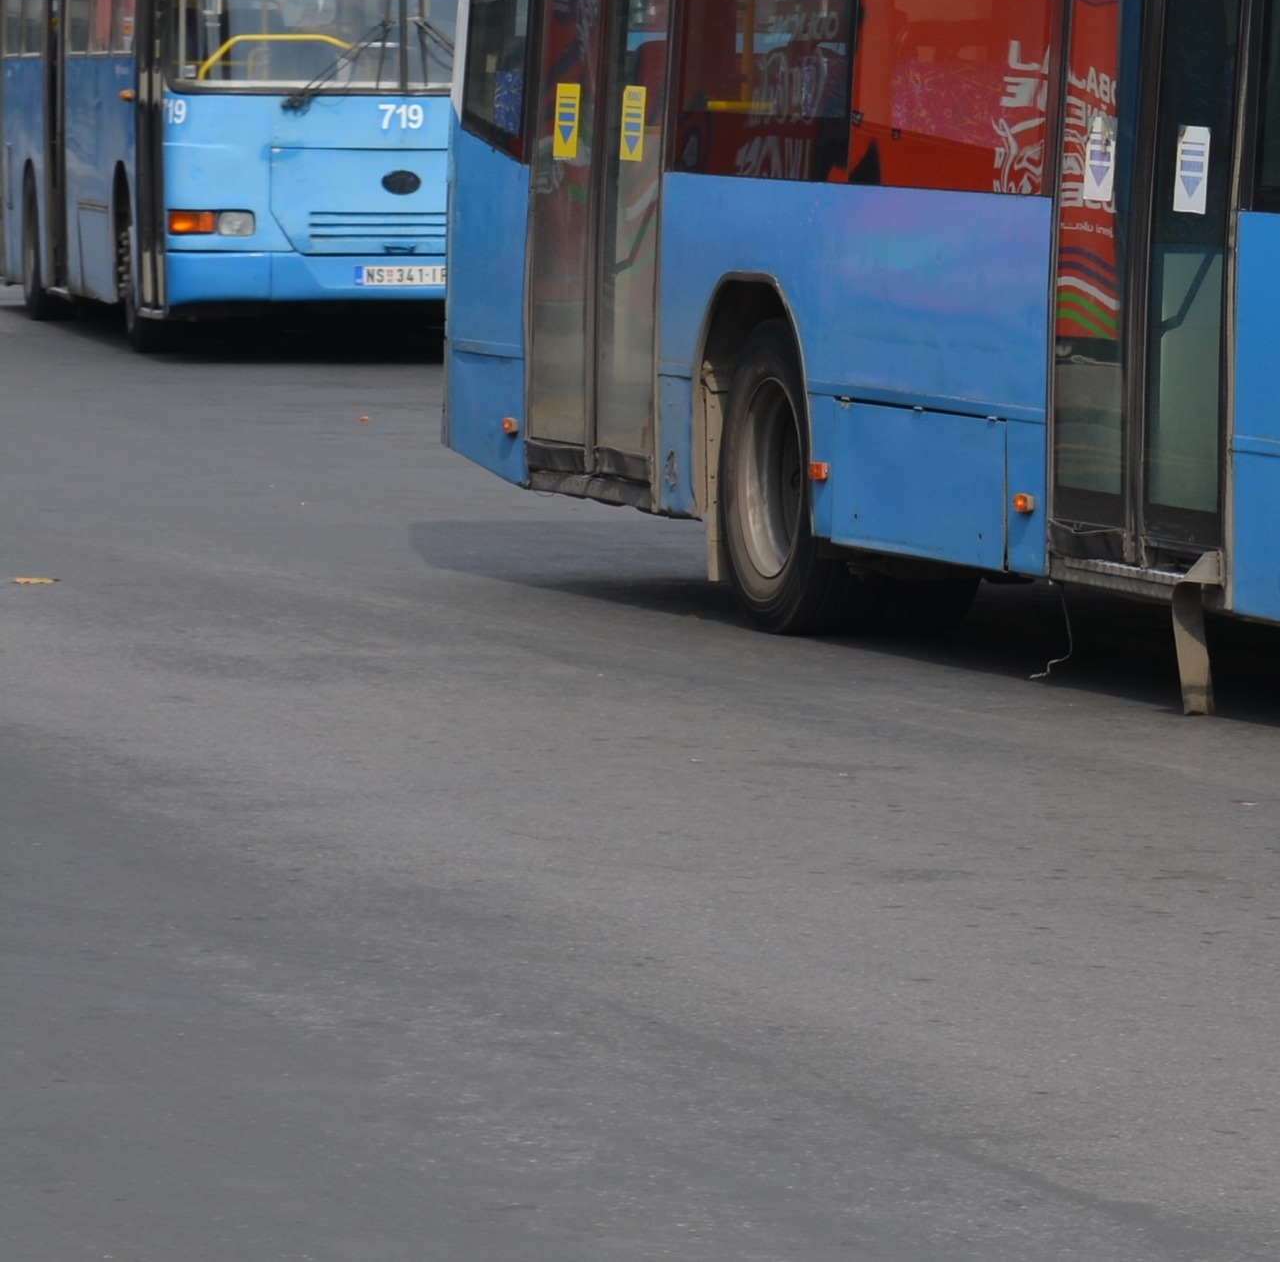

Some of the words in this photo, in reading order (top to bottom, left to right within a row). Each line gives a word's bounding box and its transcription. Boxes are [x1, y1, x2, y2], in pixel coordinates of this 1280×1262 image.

[163, 99, 187, 124] 19
[378, 104, 424, 129] 719
[366, 268, 385, 283] NS
